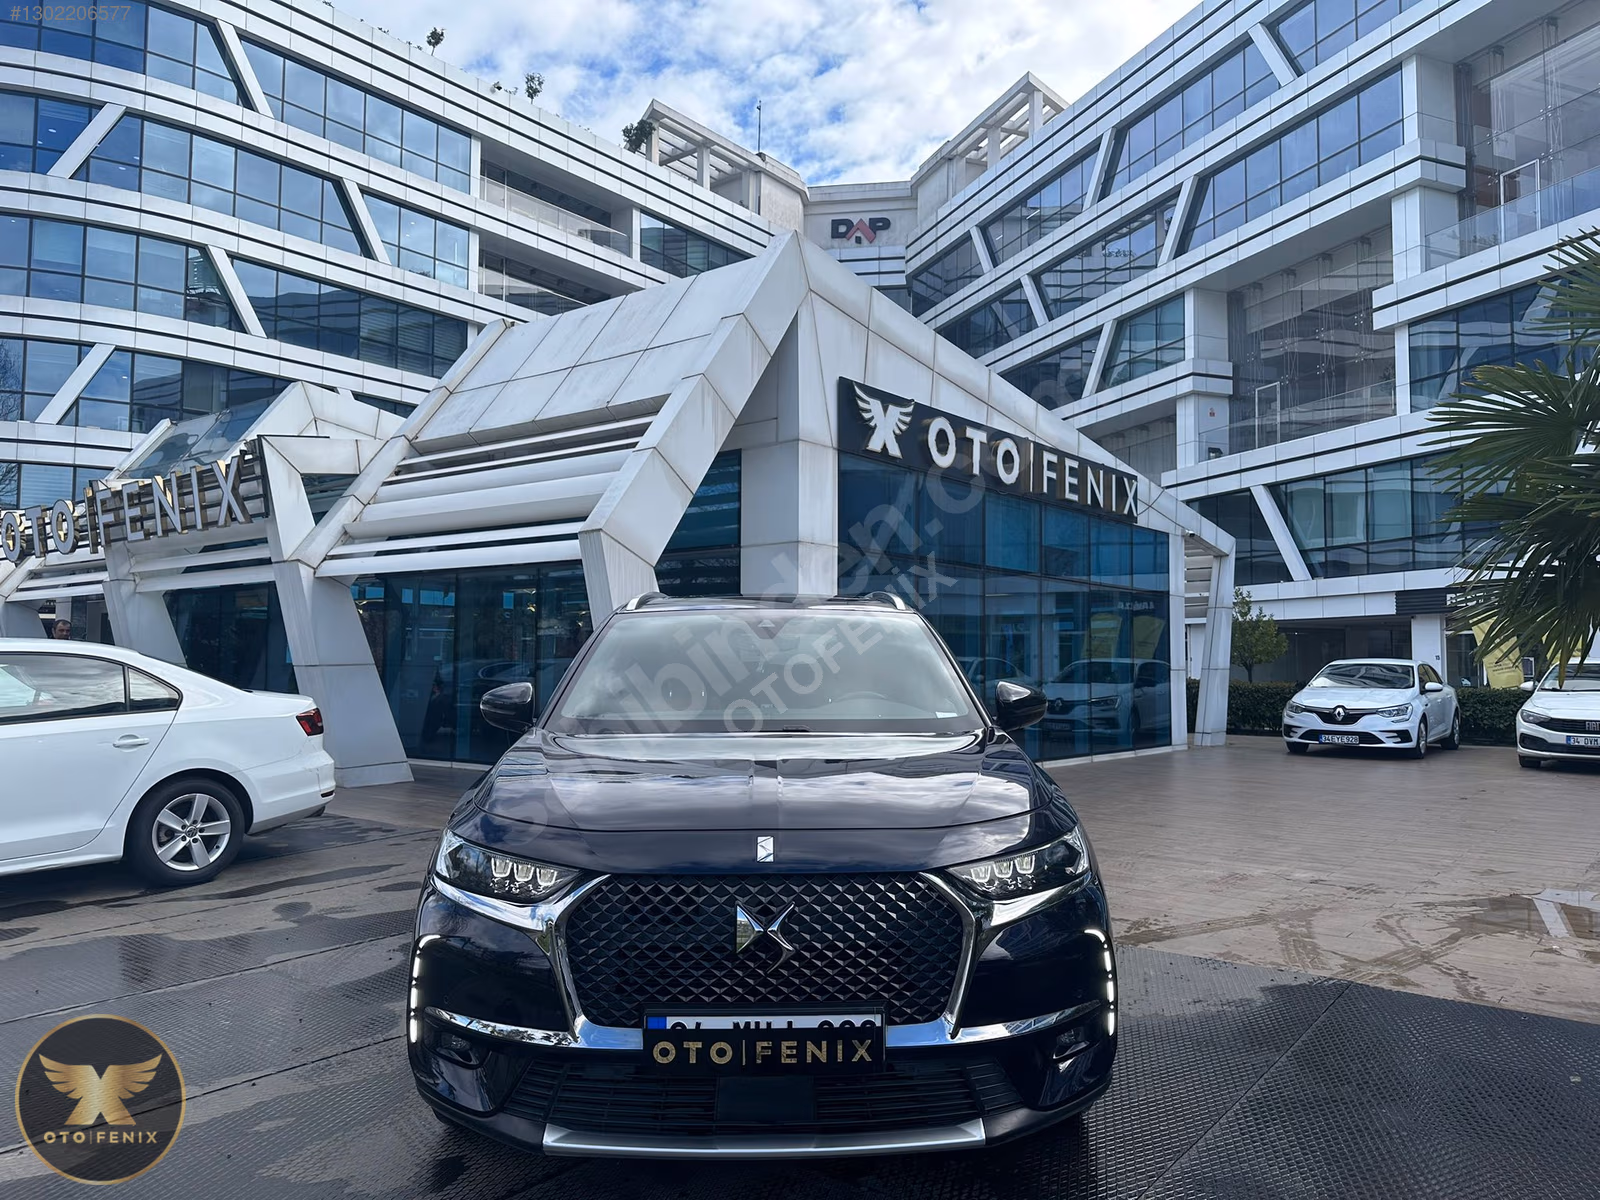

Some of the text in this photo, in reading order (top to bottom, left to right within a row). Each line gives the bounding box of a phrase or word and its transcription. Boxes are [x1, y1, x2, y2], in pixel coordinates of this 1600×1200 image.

[1, 455, 250, 563] OTO FENIX
[925, 416, 1138, 517] OTO FENIX
[652, 1039, 872, 1065] OTO FENIX
